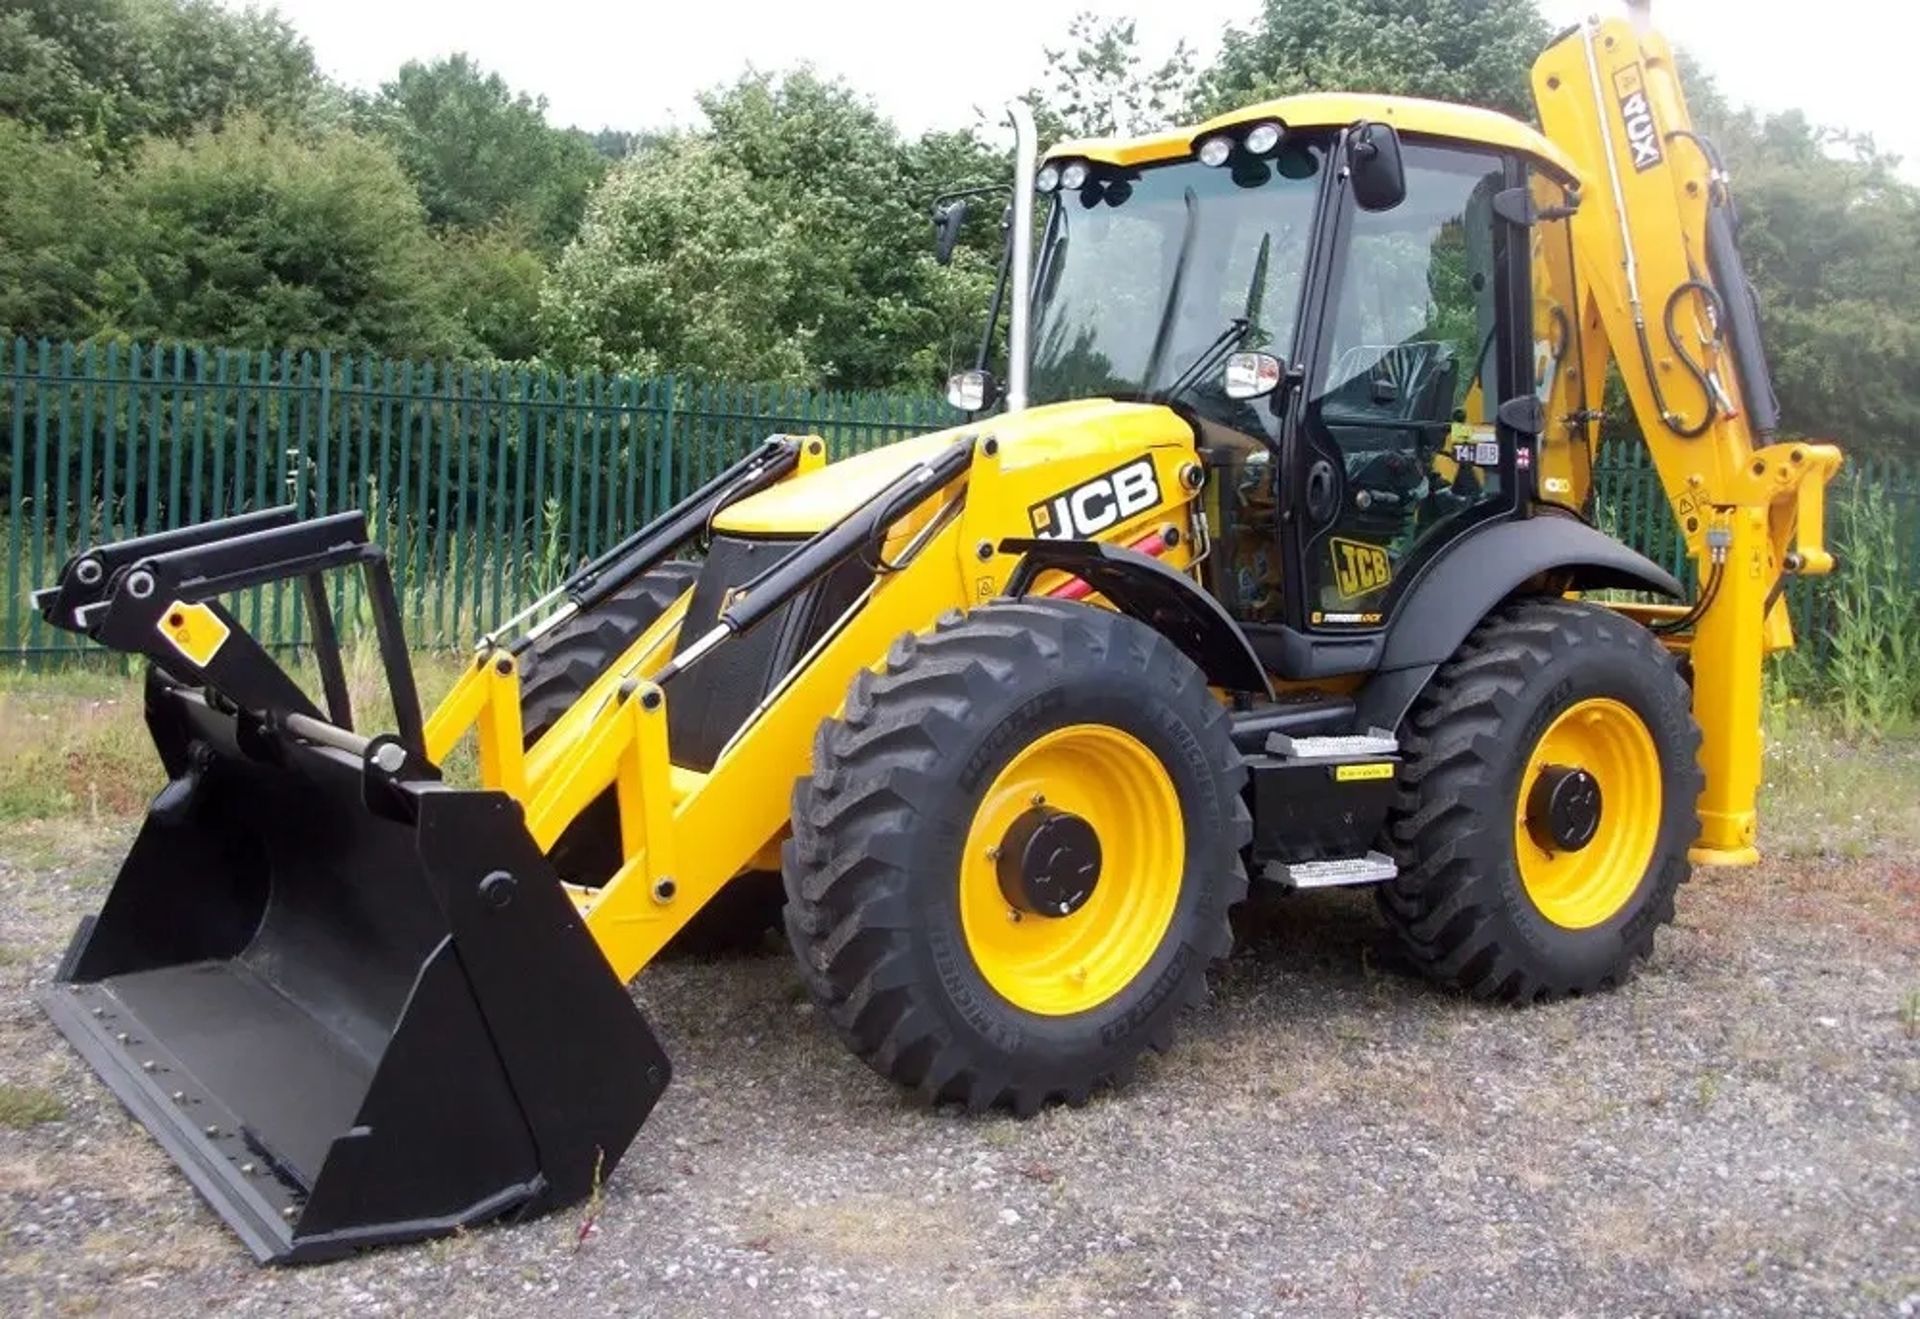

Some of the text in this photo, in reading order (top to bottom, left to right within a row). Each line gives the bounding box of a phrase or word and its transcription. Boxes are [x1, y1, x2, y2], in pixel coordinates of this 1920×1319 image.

[1623, 92, 1660, 168] 4CX
[1037, 461, 1159, 541] JCB
[1341, 544, 1387, 594] JCB
